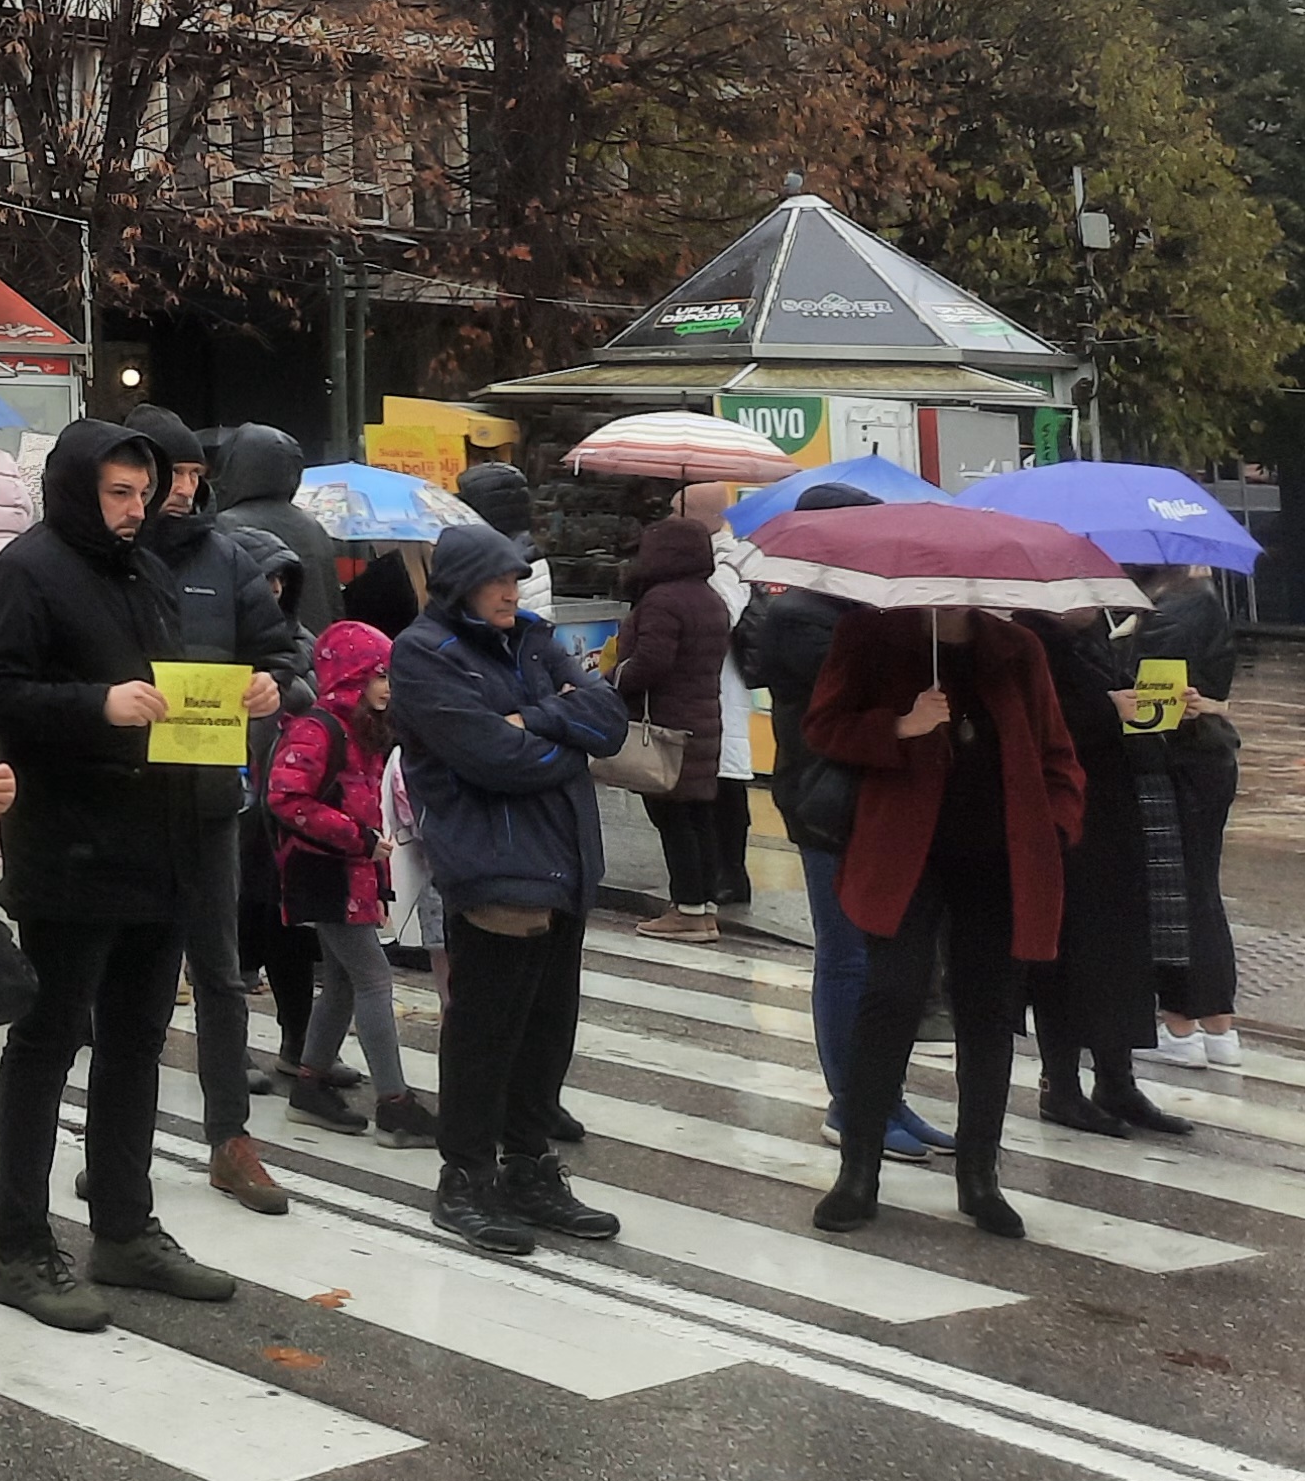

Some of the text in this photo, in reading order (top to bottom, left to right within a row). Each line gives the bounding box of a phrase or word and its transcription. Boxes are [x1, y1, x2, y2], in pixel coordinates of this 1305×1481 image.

[660, 310, 743, 324] DEPOZITA
[675, 303, 739, 316] UPLATA
[737, 407, 805, 439] NOVO
[1147, 498, 1208, 522] Milka
